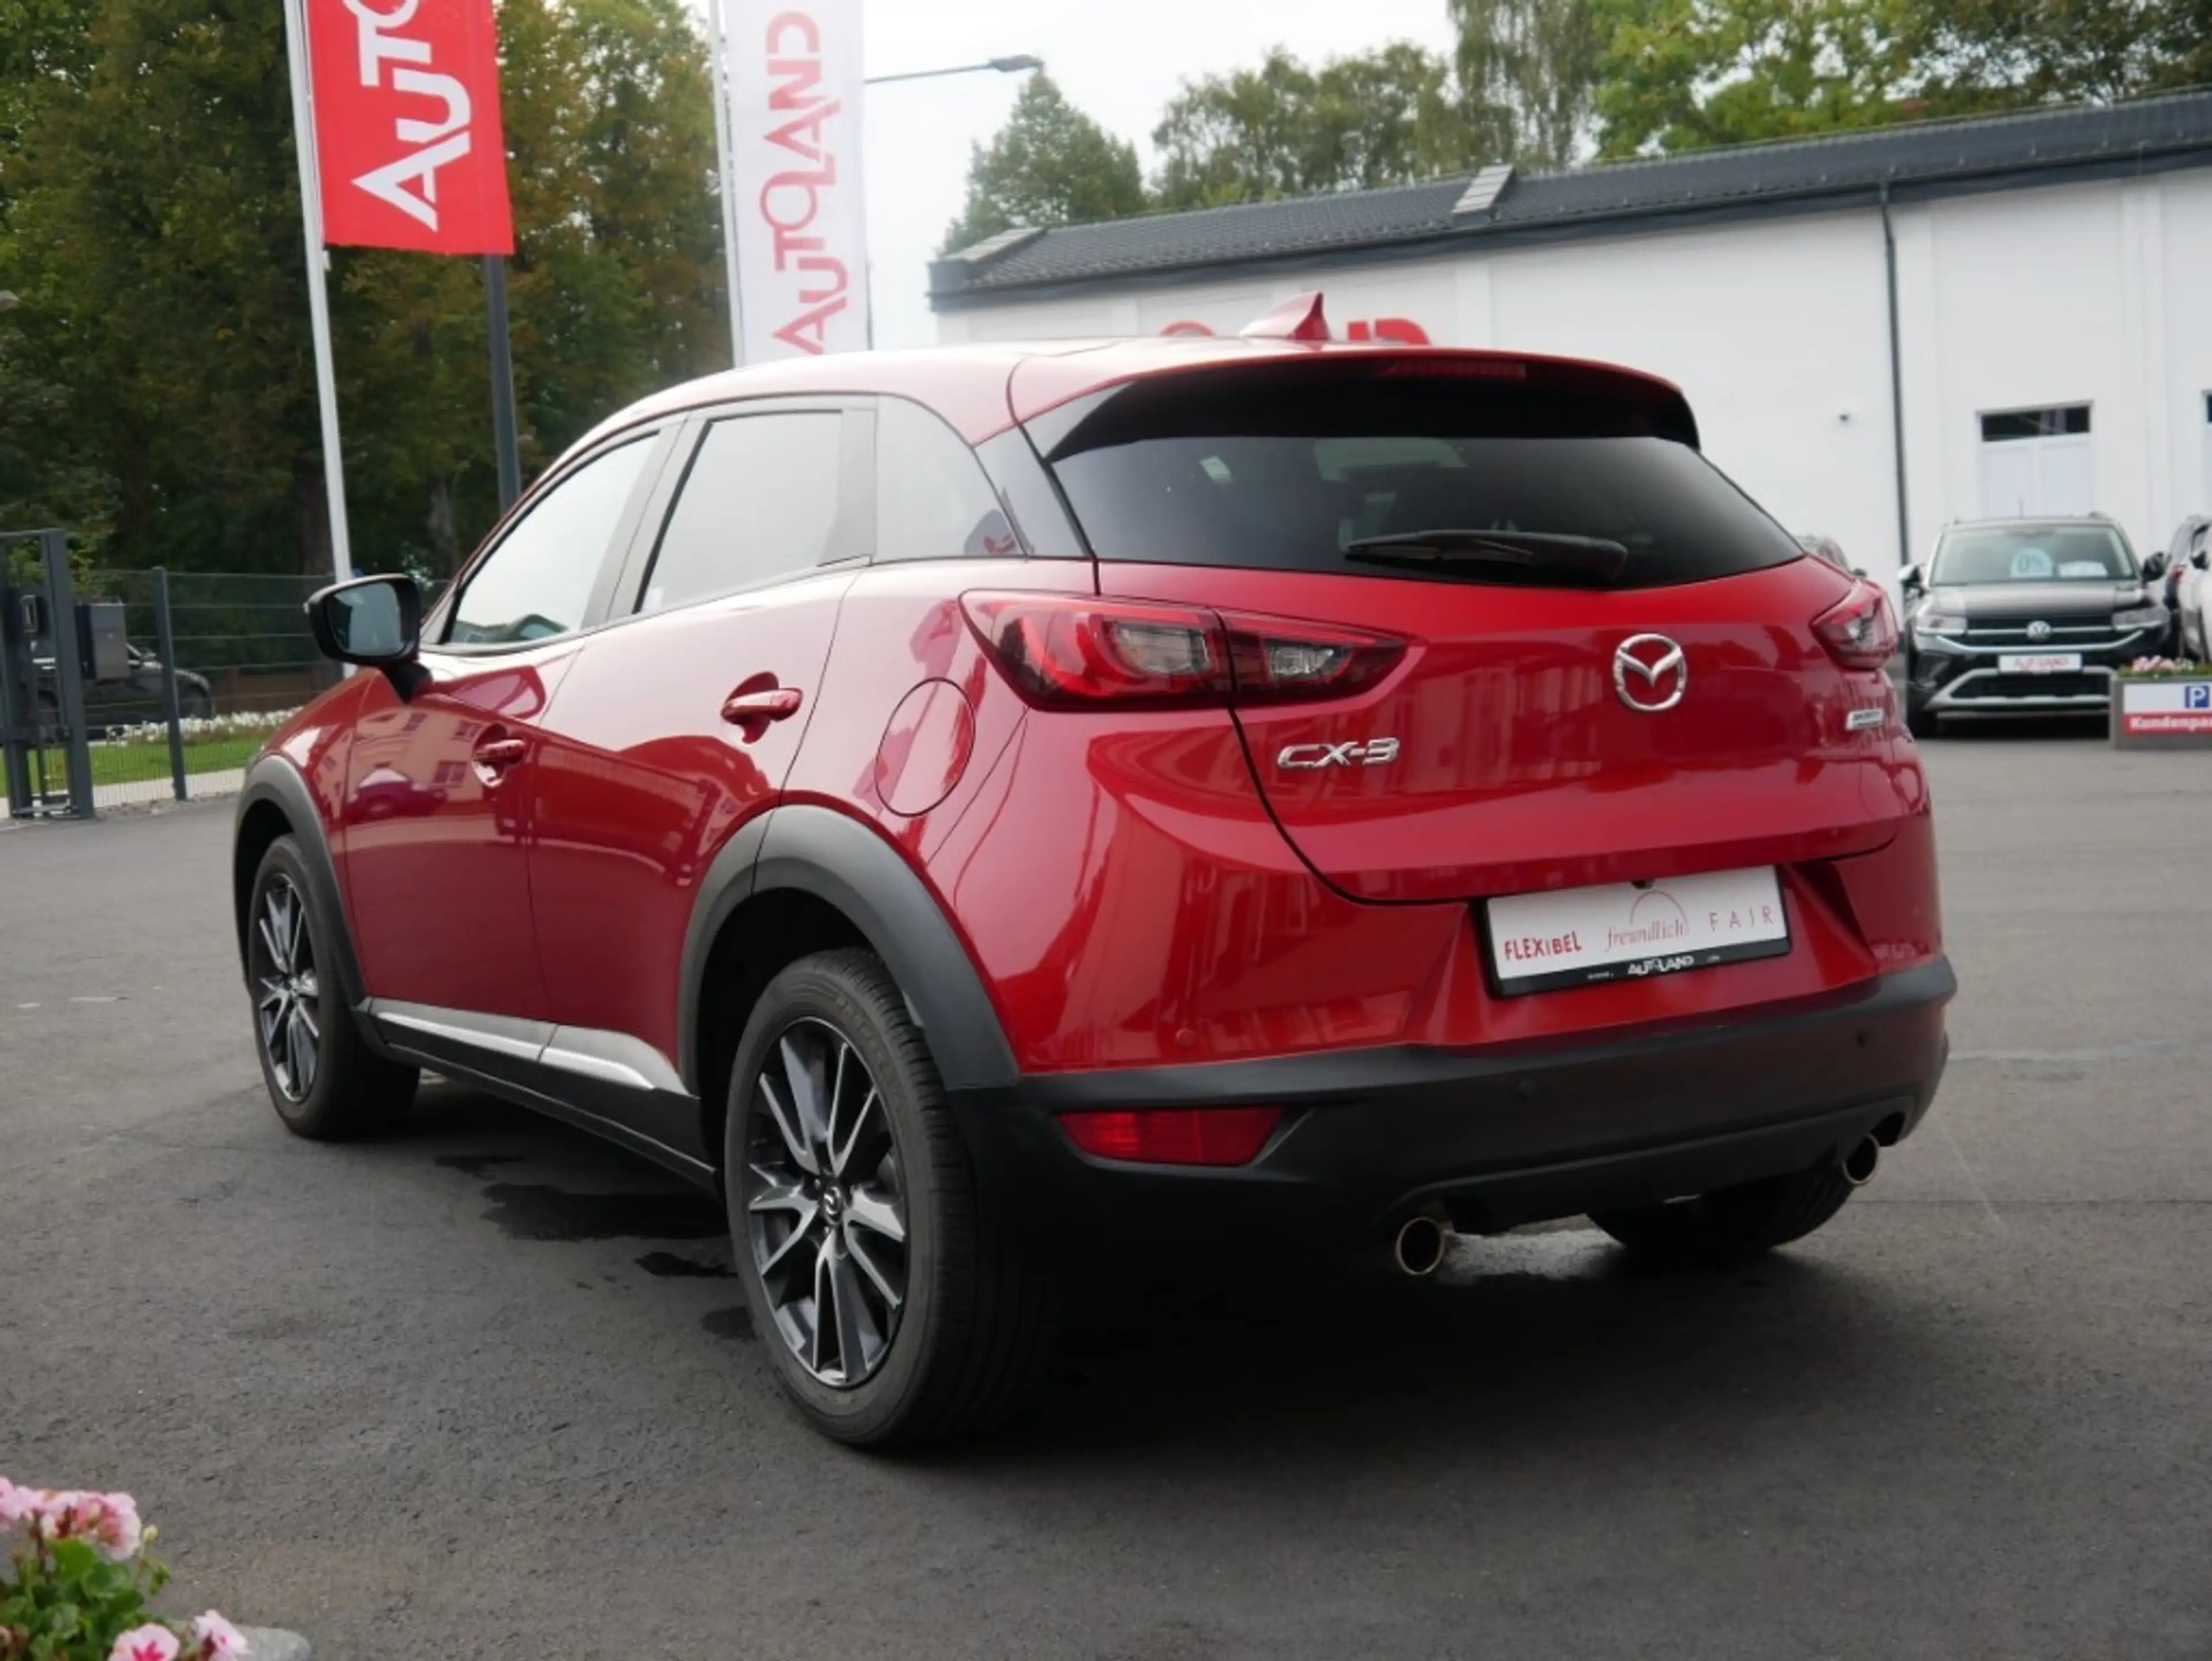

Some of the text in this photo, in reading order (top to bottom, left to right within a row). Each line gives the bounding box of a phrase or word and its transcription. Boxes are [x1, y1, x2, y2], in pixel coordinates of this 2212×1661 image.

[759, 10, 848, 355] AUTOLAND
[2190, 687, 2206, 708] P
[2130, 716, 2212, 732] Kundenpa
[1277, 737, 1400, 768] CX-3
[1504, 905, 1773, 961] FLEXIBEL freundlich FAIR
